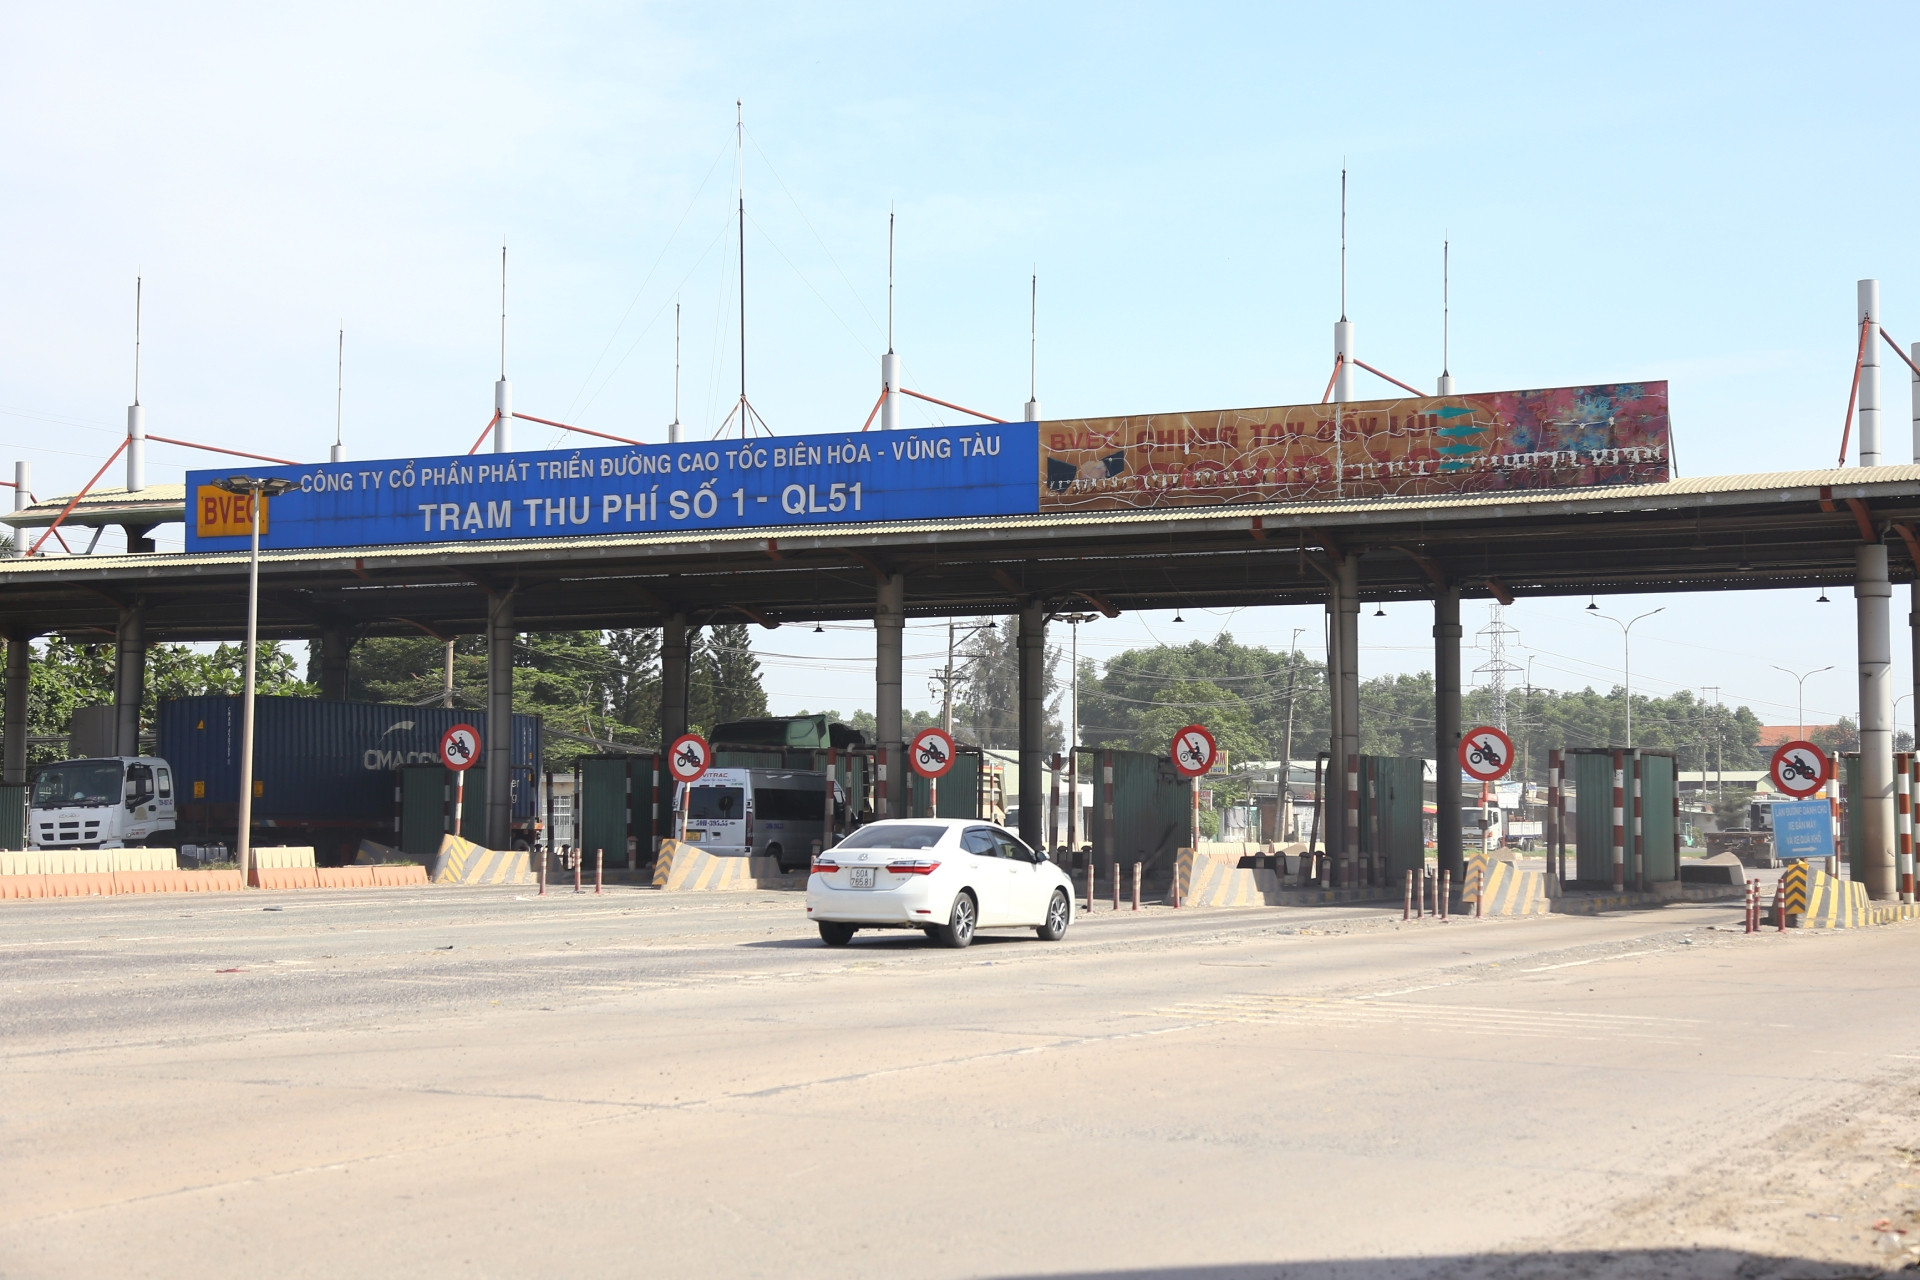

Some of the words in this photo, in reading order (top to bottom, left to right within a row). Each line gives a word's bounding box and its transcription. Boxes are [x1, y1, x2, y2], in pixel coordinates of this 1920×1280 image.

[301, 469, 353, 493] CÔNG
[359, 471, 383, 490] TY
[388, 459, 417, 489] CỔ
[421, 459, 473, 487] PHẦN
[477, 458, 531, 484] PHÁT
[536, 450, 595, 480] TRIỂN
[600, 450, 671, 477] ĐƯỜNG
[677, 451, 720, 473] CAO
[725, 443, 768, 470] TỐC
[774, 442, 821, 467] BIÊN
[827, 438, 871, 464] HÒA
[892, 435, 951, 461] VŨNG
[960, 431, 1001, 457] TÀU
[418, 500, 512, 534] TRẠM
[522, 496, 590, 528] THU
[602, 484, 659, 523] PHÍ
[669, 477, 718, 519] SỐ
[732, 487, 745, 517] 1
[781, 481, 863, 516] QL51
[856, 869, 868, 877] 60A
